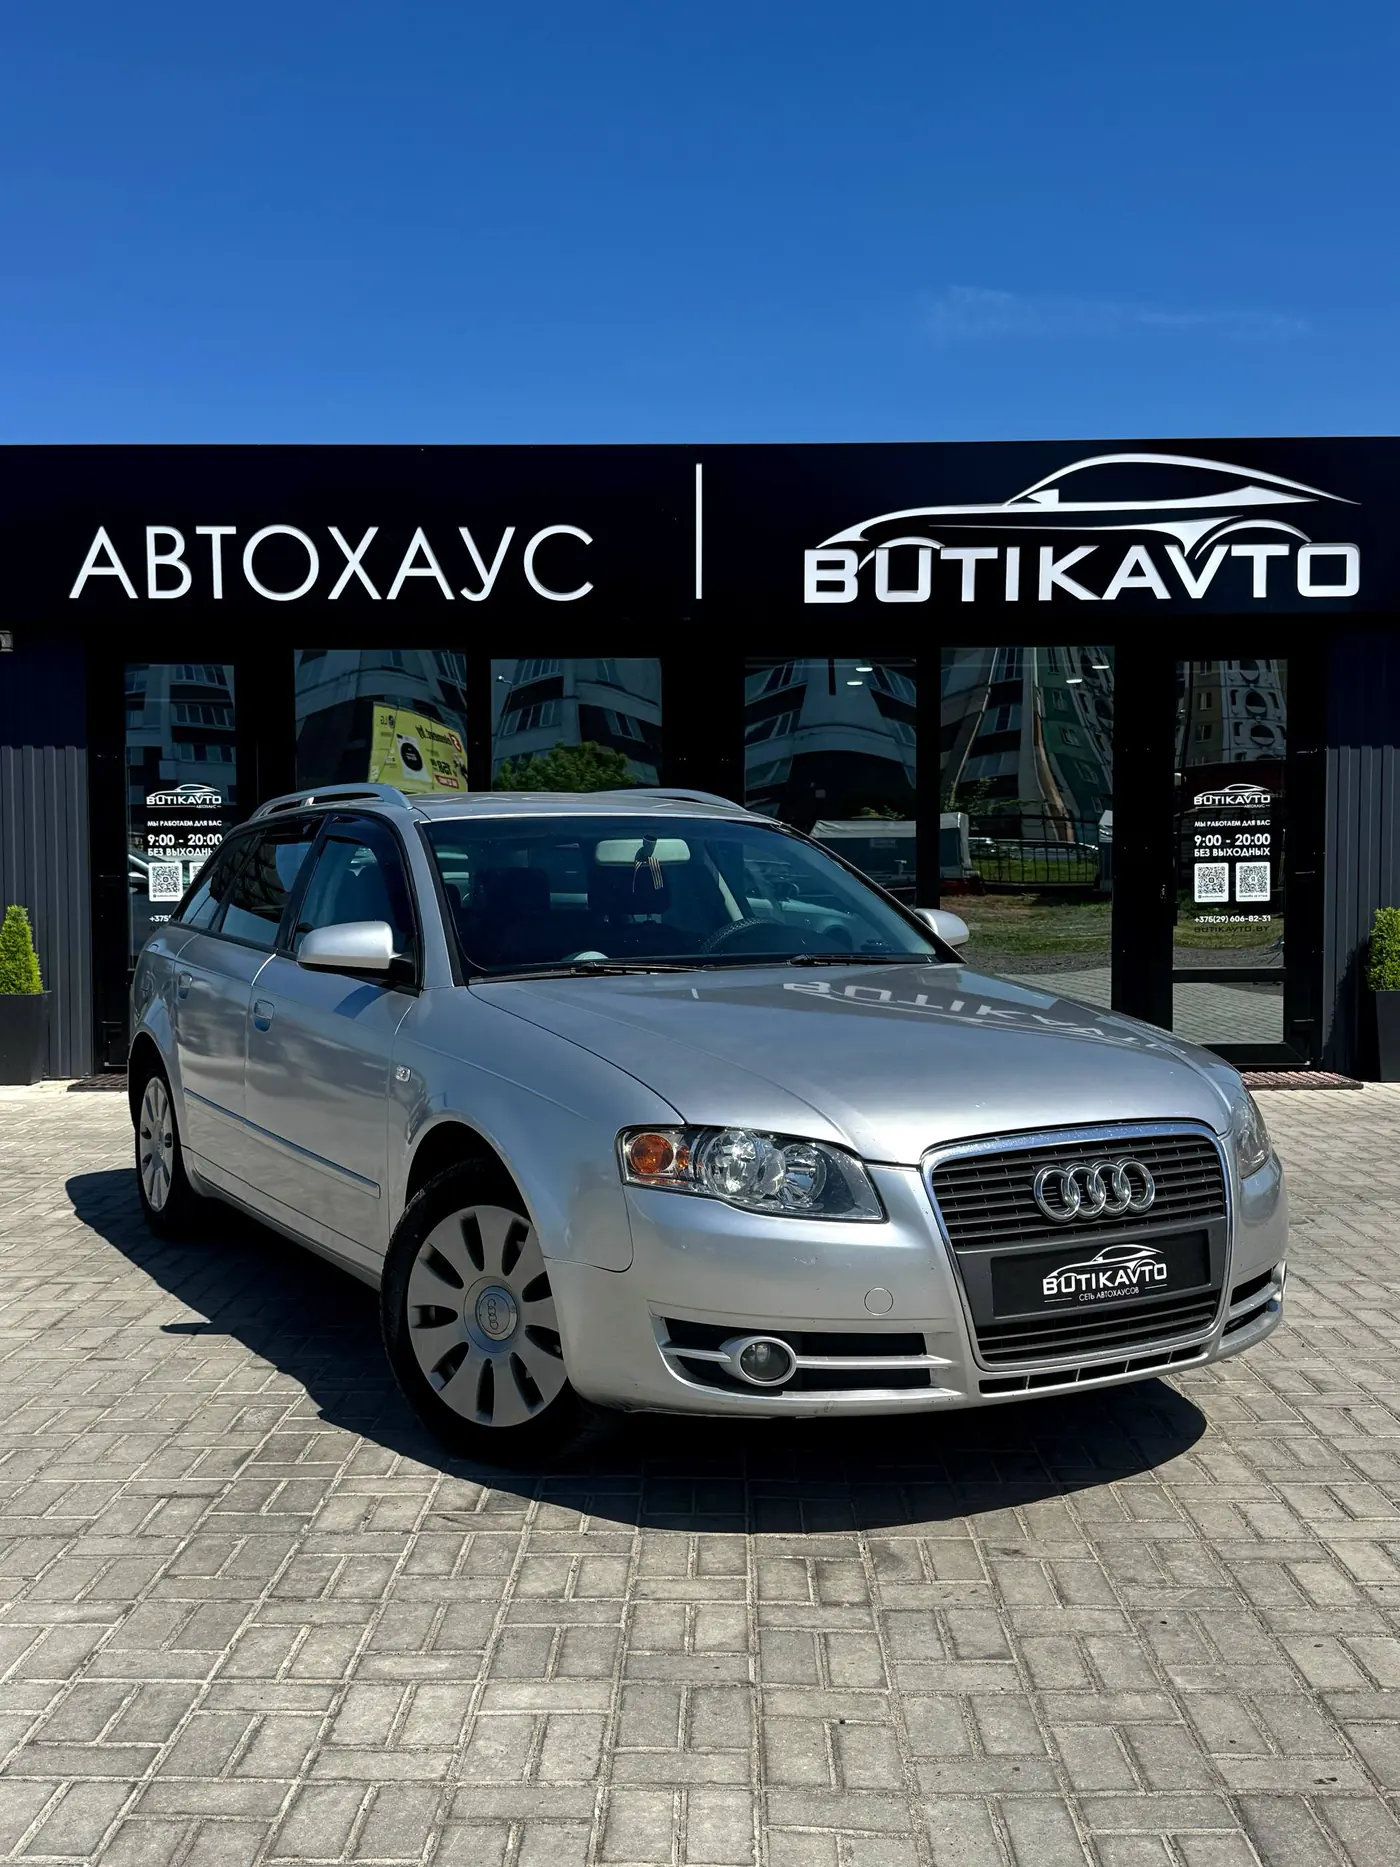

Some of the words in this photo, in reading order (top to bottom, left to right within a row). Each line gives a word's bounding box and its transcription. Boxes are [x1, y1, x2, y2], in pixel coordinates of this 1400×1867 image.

[69, 524, 594, 602] АВТОХАУС
[804, 543, 1361, 604] BUTIKAVTO
[146, 795, 222, 805] BUTIKAVTO
[1194, 795, 1271, 805] BUTIKAVTO
[147, 834, 175, 846] 9:00
[187, 833, 223, 846] 20:00
[1194, 834, 1222, 847] 9:00
[1234, 833, 1271, 846] 20:00
[147, 847, 164, 856] БЕЗ
[1194, 848, 1210, 857] БЕЗ
[1212, 847, 1271, 857] ВЫХОДНЫХ
[1194, 915, 1229, 924] +375(29)
[1229, 914, 1271, 922] 606-82-31
[1194, 925, 1270, 933] BUTIKAVTO.BY
[1042, 1263, 1168, 1296] BUTIKAVTO
[1079, 1292, 1095, 1302] СЕТЬ
[1096, 1286, 1140, 1300] АВТОХАУСОВ
